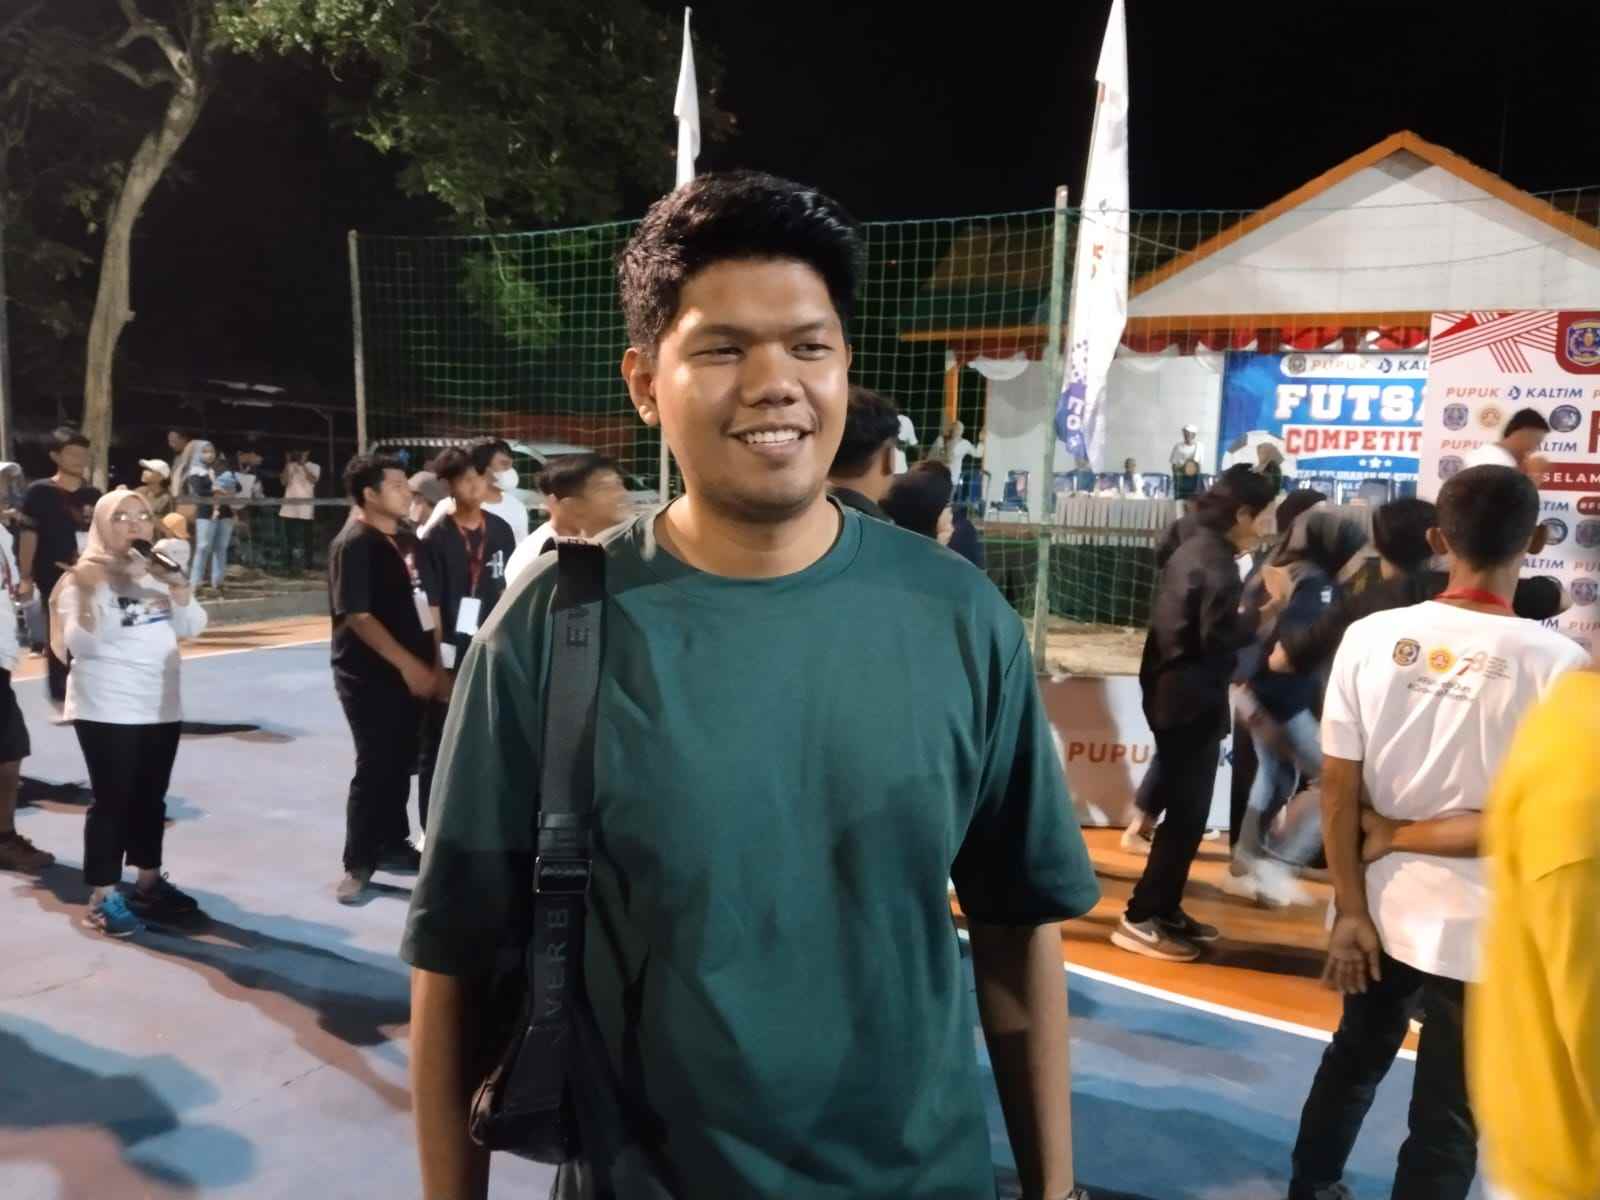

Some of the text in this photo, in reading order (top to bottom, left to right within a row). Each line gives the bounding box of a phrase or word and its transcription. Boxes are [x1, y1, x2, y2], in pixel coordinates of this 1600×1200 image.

[1446, 387, 1500, 399] PUPUK
[1525, 387, 1584, 399] KALTIM
[1286, 429, 1422, 454] COMPETIT
[1067, 741, 1150, 764] PUPU
